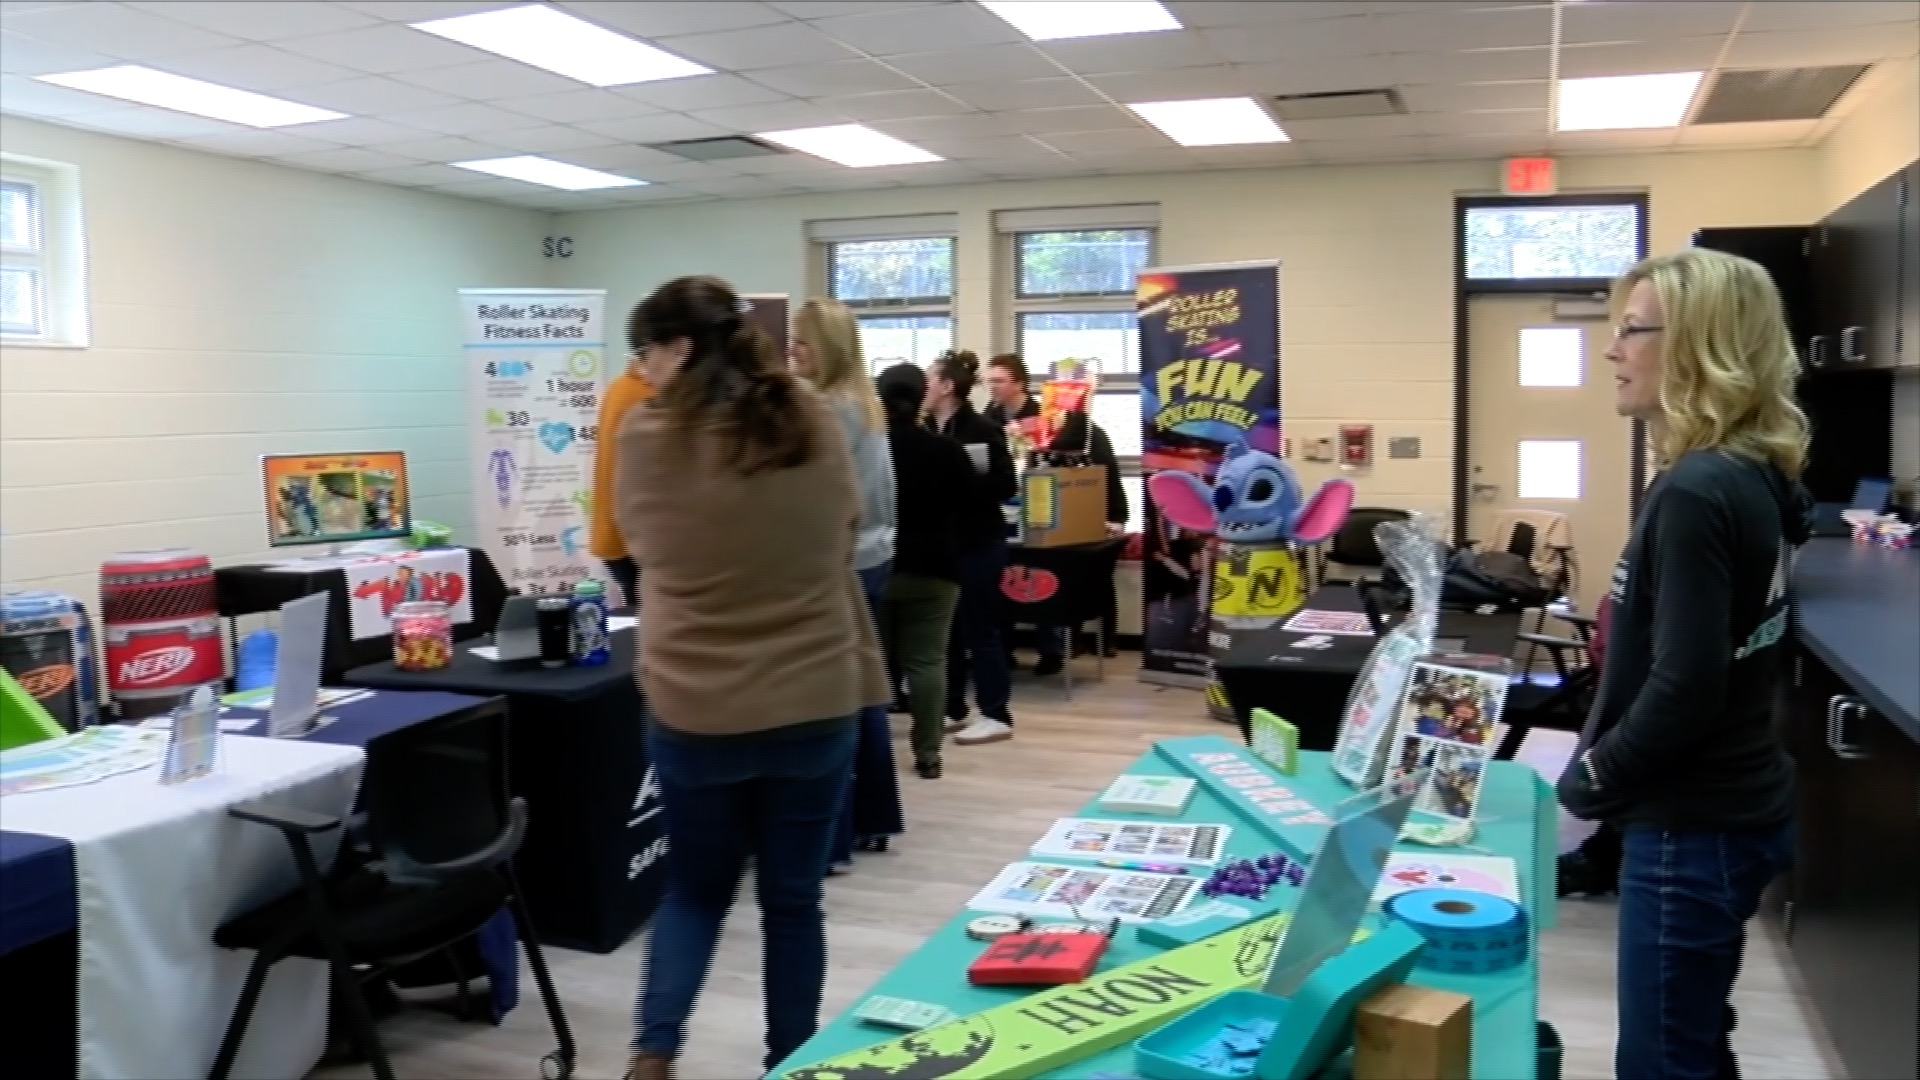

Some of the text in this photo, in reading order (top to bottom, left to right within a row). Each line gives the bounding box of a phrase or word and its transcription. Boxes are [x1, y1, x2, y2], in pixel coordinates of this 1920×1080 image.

[543, 236, 573, 258] SC
[1170, 288, 1237, 313] ROLLER
[478, 304, 589, 323] Roller Skating
[1165, 306, 1241, 333] SKATING
[484, 324, 584, 339] Fitness Facts
[558, 378, 595, 393] hour
[1156, 358, 1264, 408] FUN
[570, 395, 597, 408] 600
[507, 411, 529, 426] 30
[1155, 400, 1259, 431] YOU CAN FEEL!
[529, 532, 556, 545] Less
[512, 567, 544, 580] Roller
[119, 647, 193, 684] NERF
[18, 667, 70, 692] ERF
[1017, 964, 1211, 1036] NOAH
